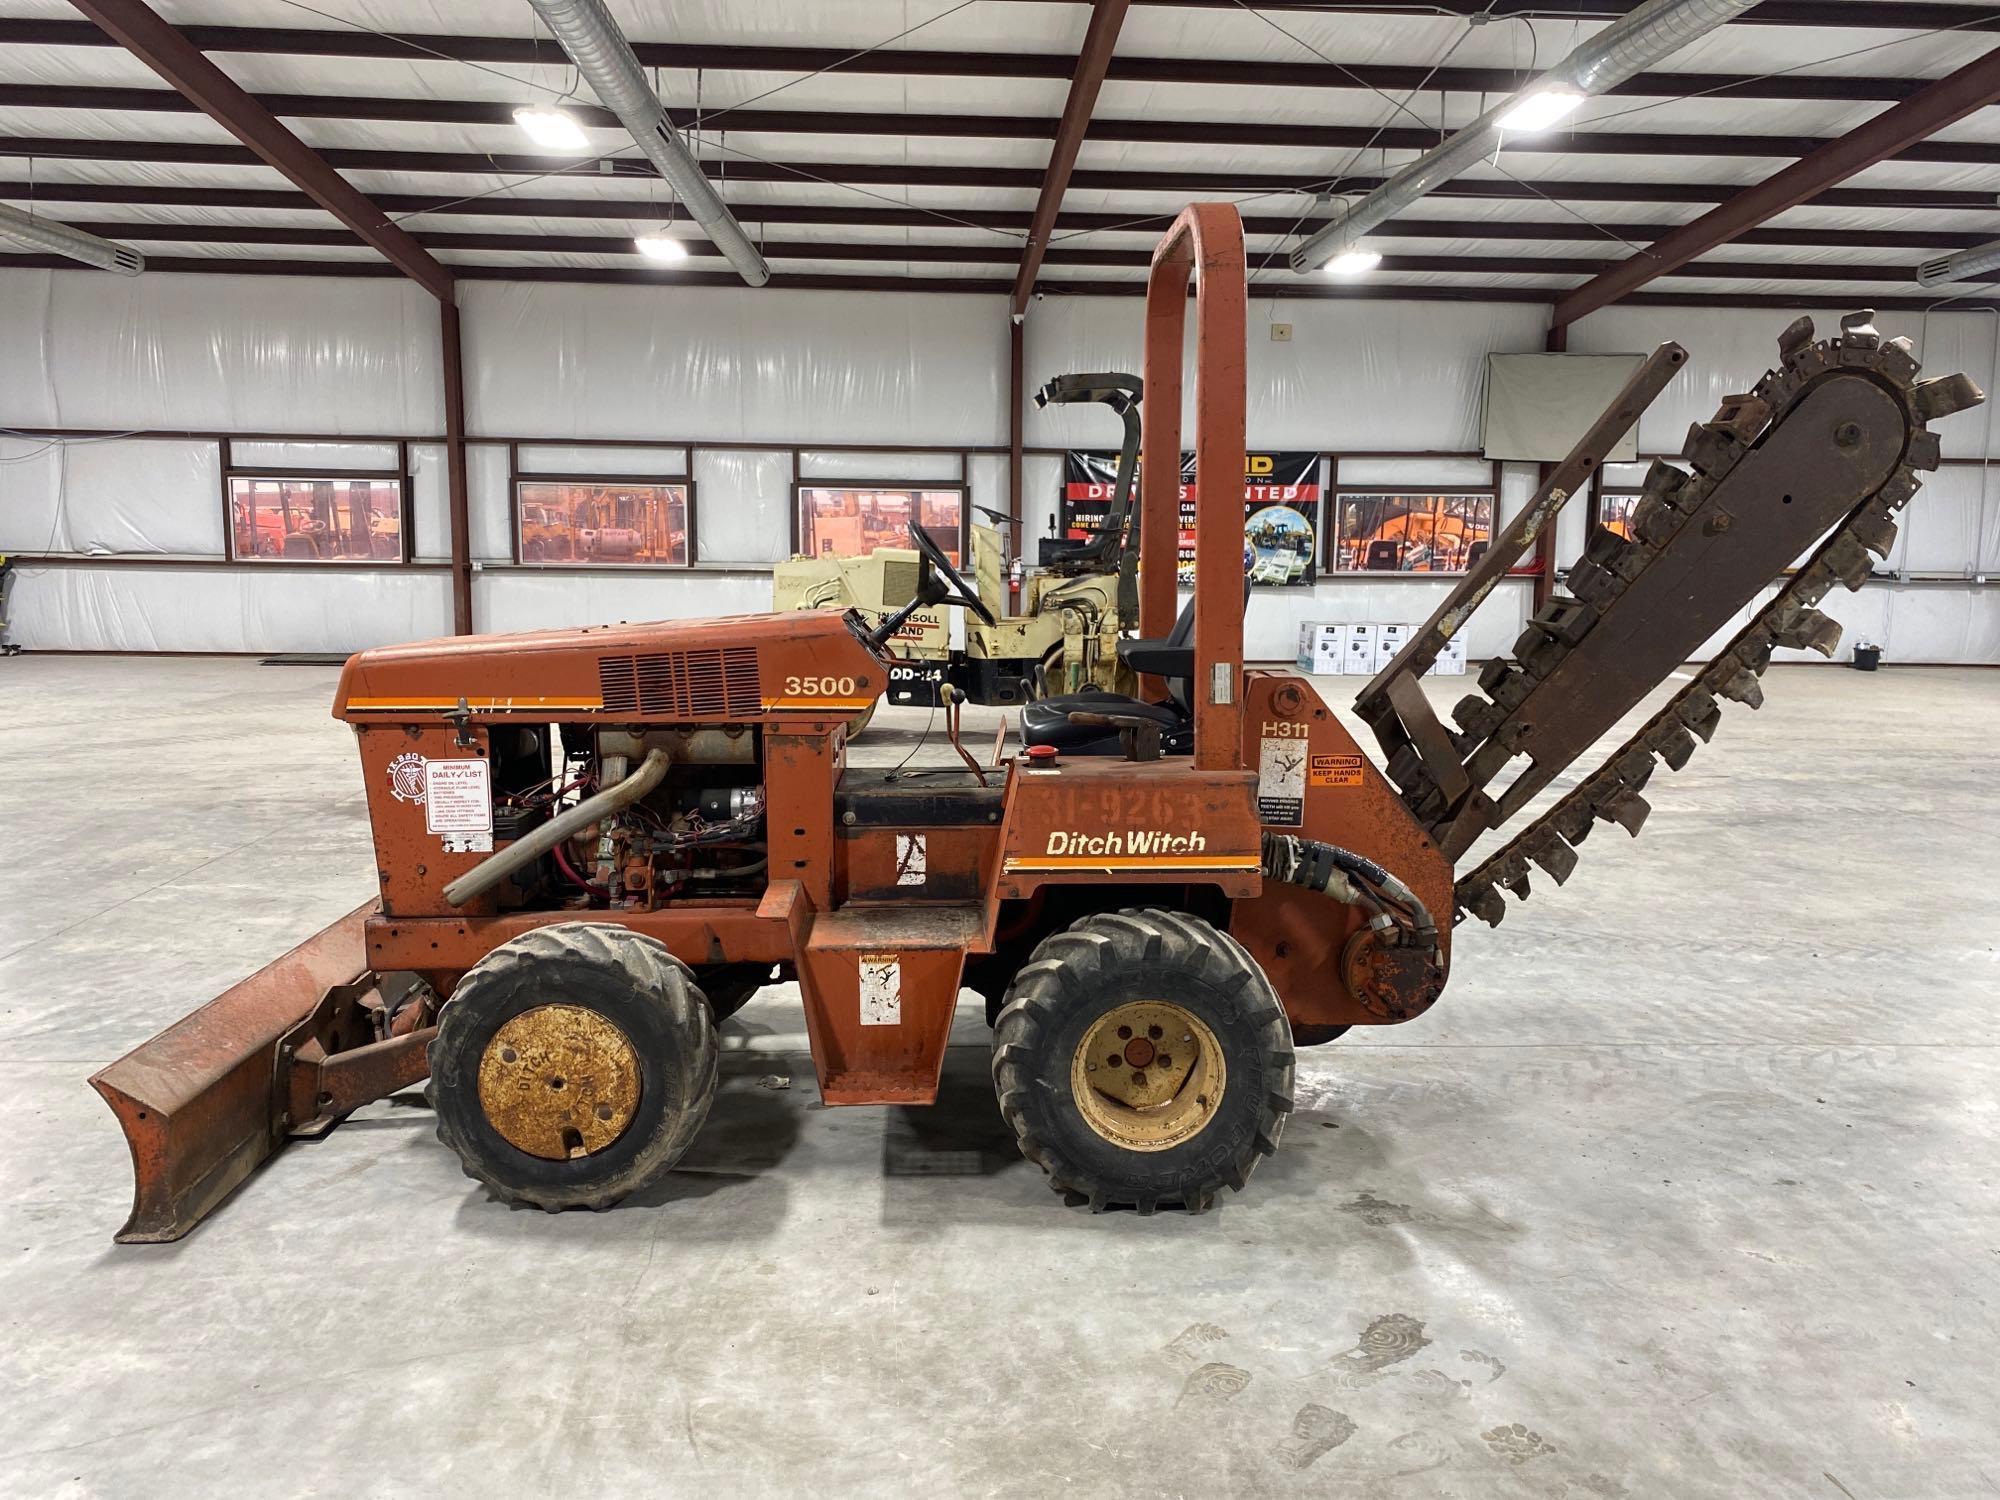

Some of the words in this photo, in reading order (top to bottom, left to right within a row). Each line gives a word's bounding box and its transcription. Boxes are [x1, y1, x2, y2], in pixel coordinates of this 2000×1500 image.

[784, 676, 855, 696] 3500
[1261, 721, 1310, 738] H311
[1316, 758, 1358, 766] WARNING
[1312, 769, 1332, 777] KEEP
[1046, 831, 1122, 855] Ditch
[1127, 830, 1206, 855] Witch
